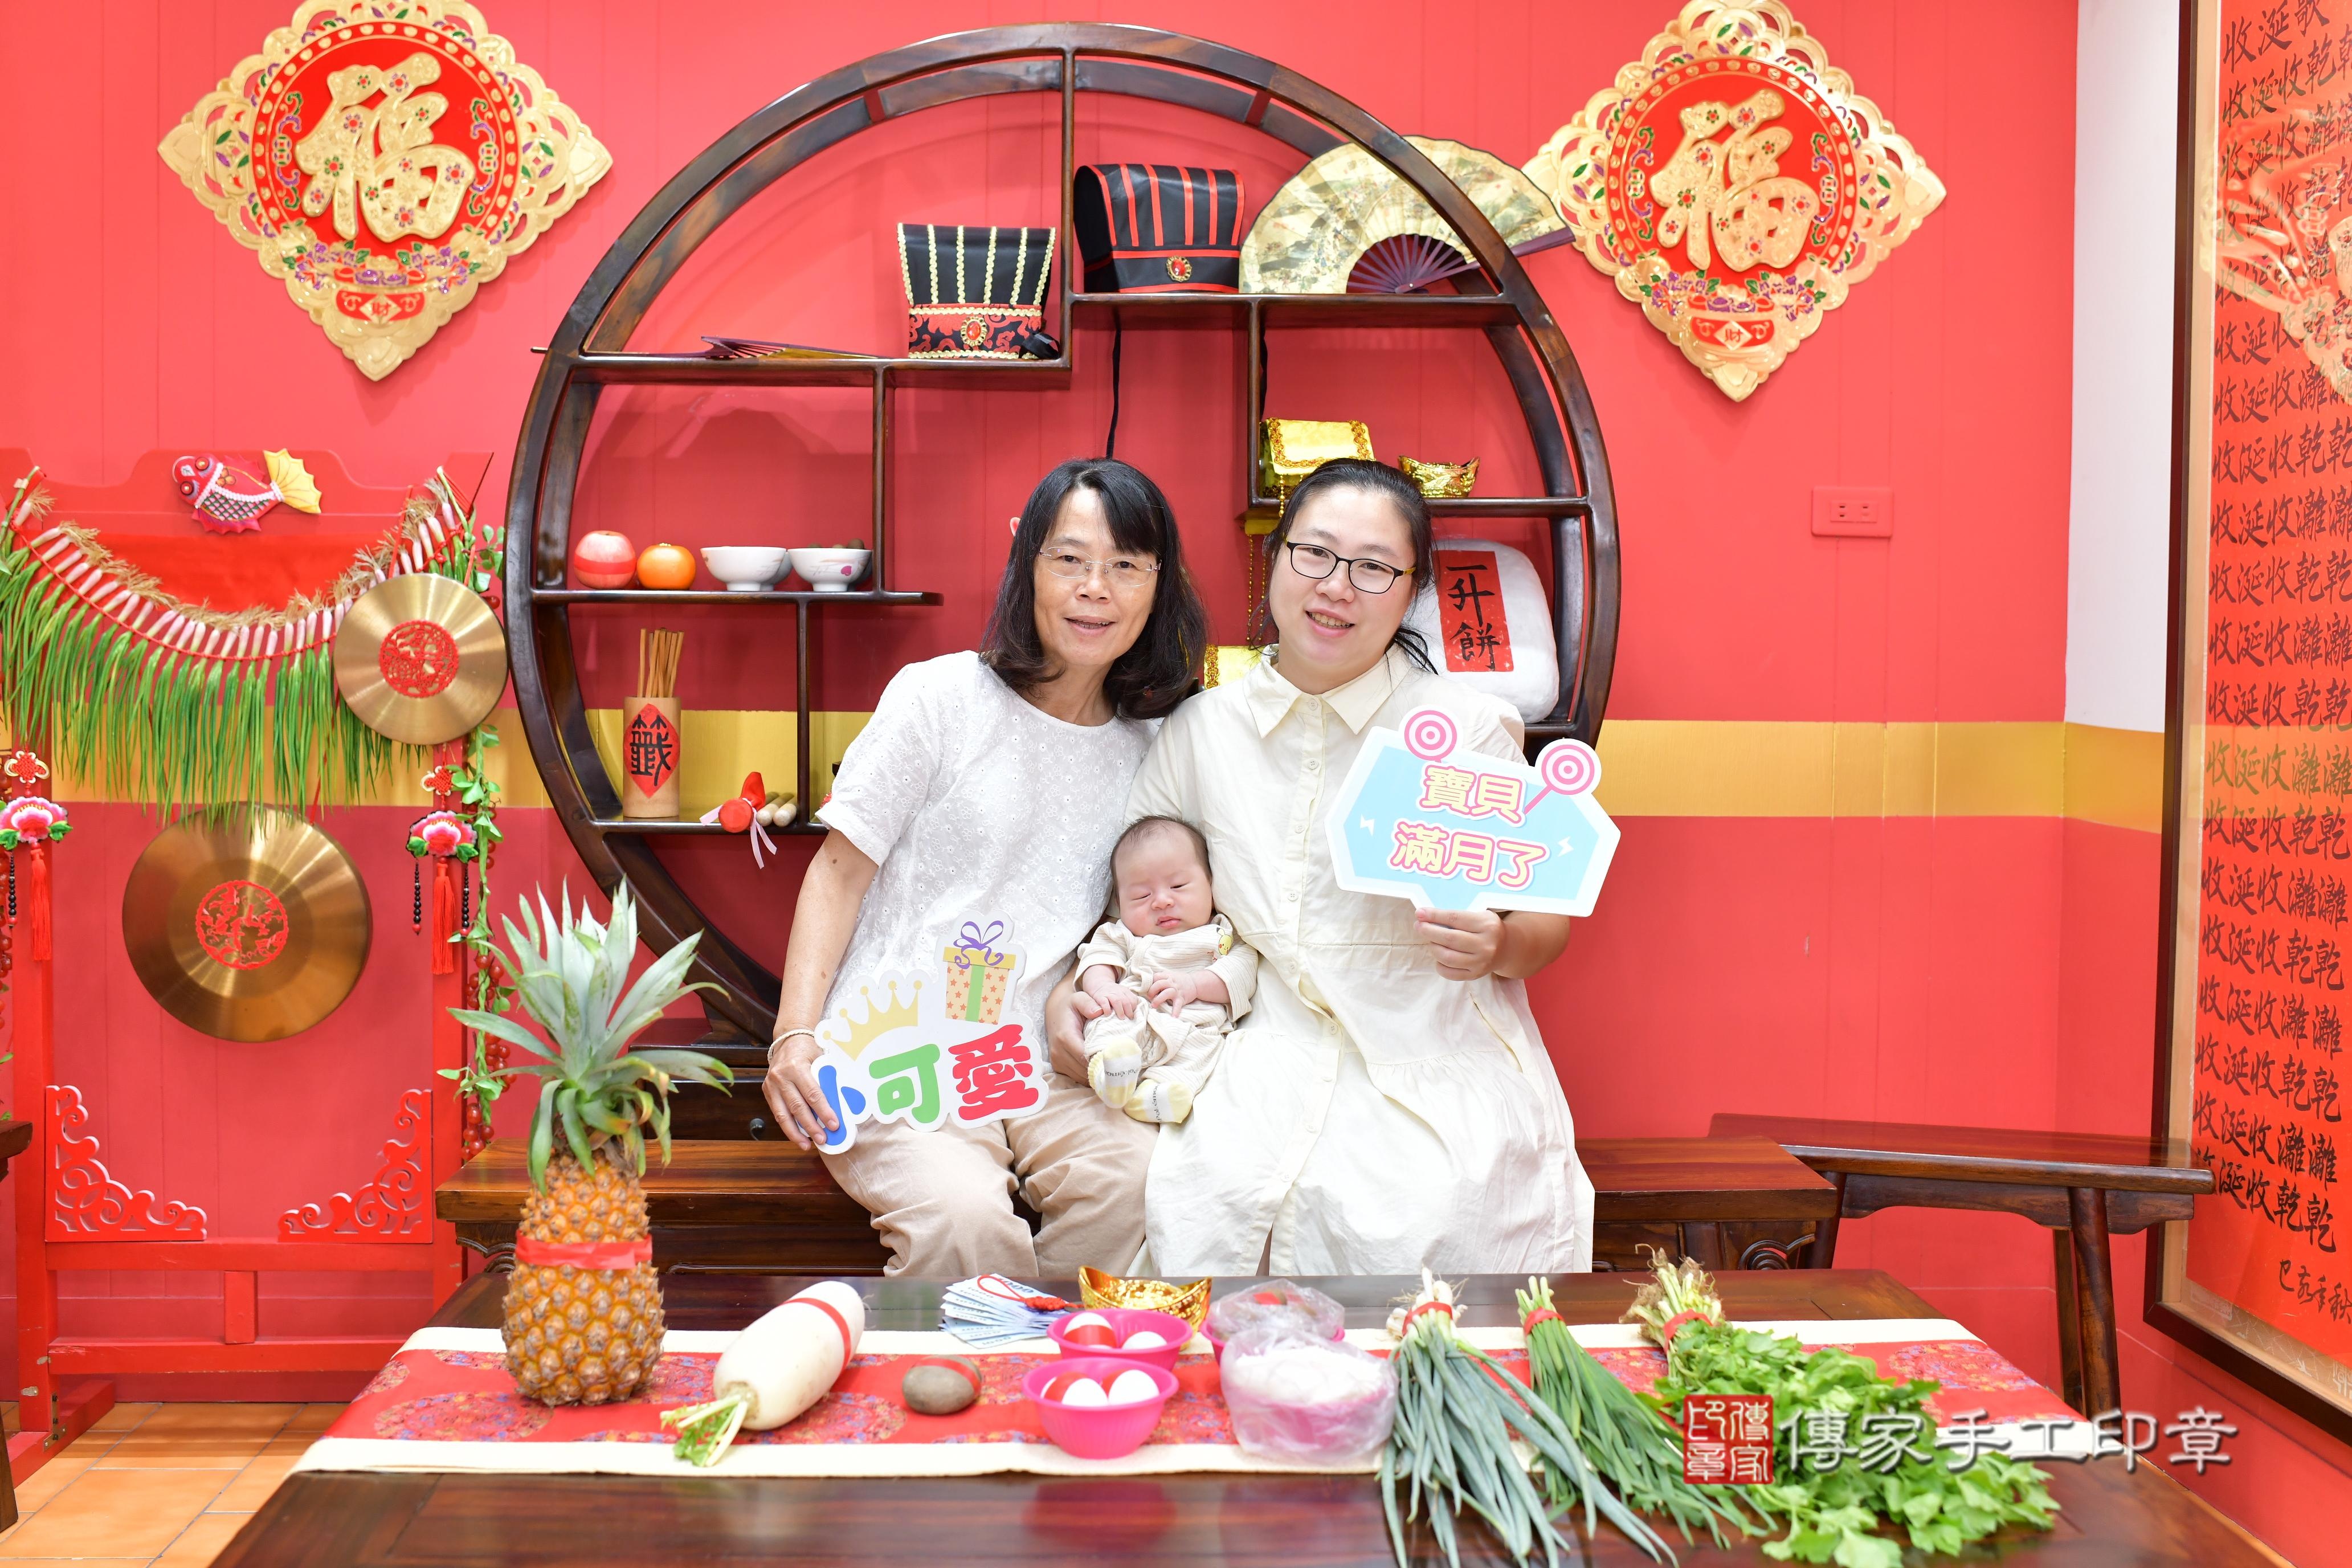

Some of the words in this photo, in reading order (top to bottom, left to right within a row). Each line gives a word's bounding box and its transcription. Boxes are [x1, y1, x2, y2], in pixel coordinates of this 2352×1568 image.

[296, 51, 475, 243] 福
[1649, 89, 1820, 272] 福
[1446, 564, 1500, 671] 一升餅
[1419, 764, 1522, 824] 寶貝
[1390, 821, 1546, 888] 滿月了
[798, 1024, 1039, 1146] 小可愛
